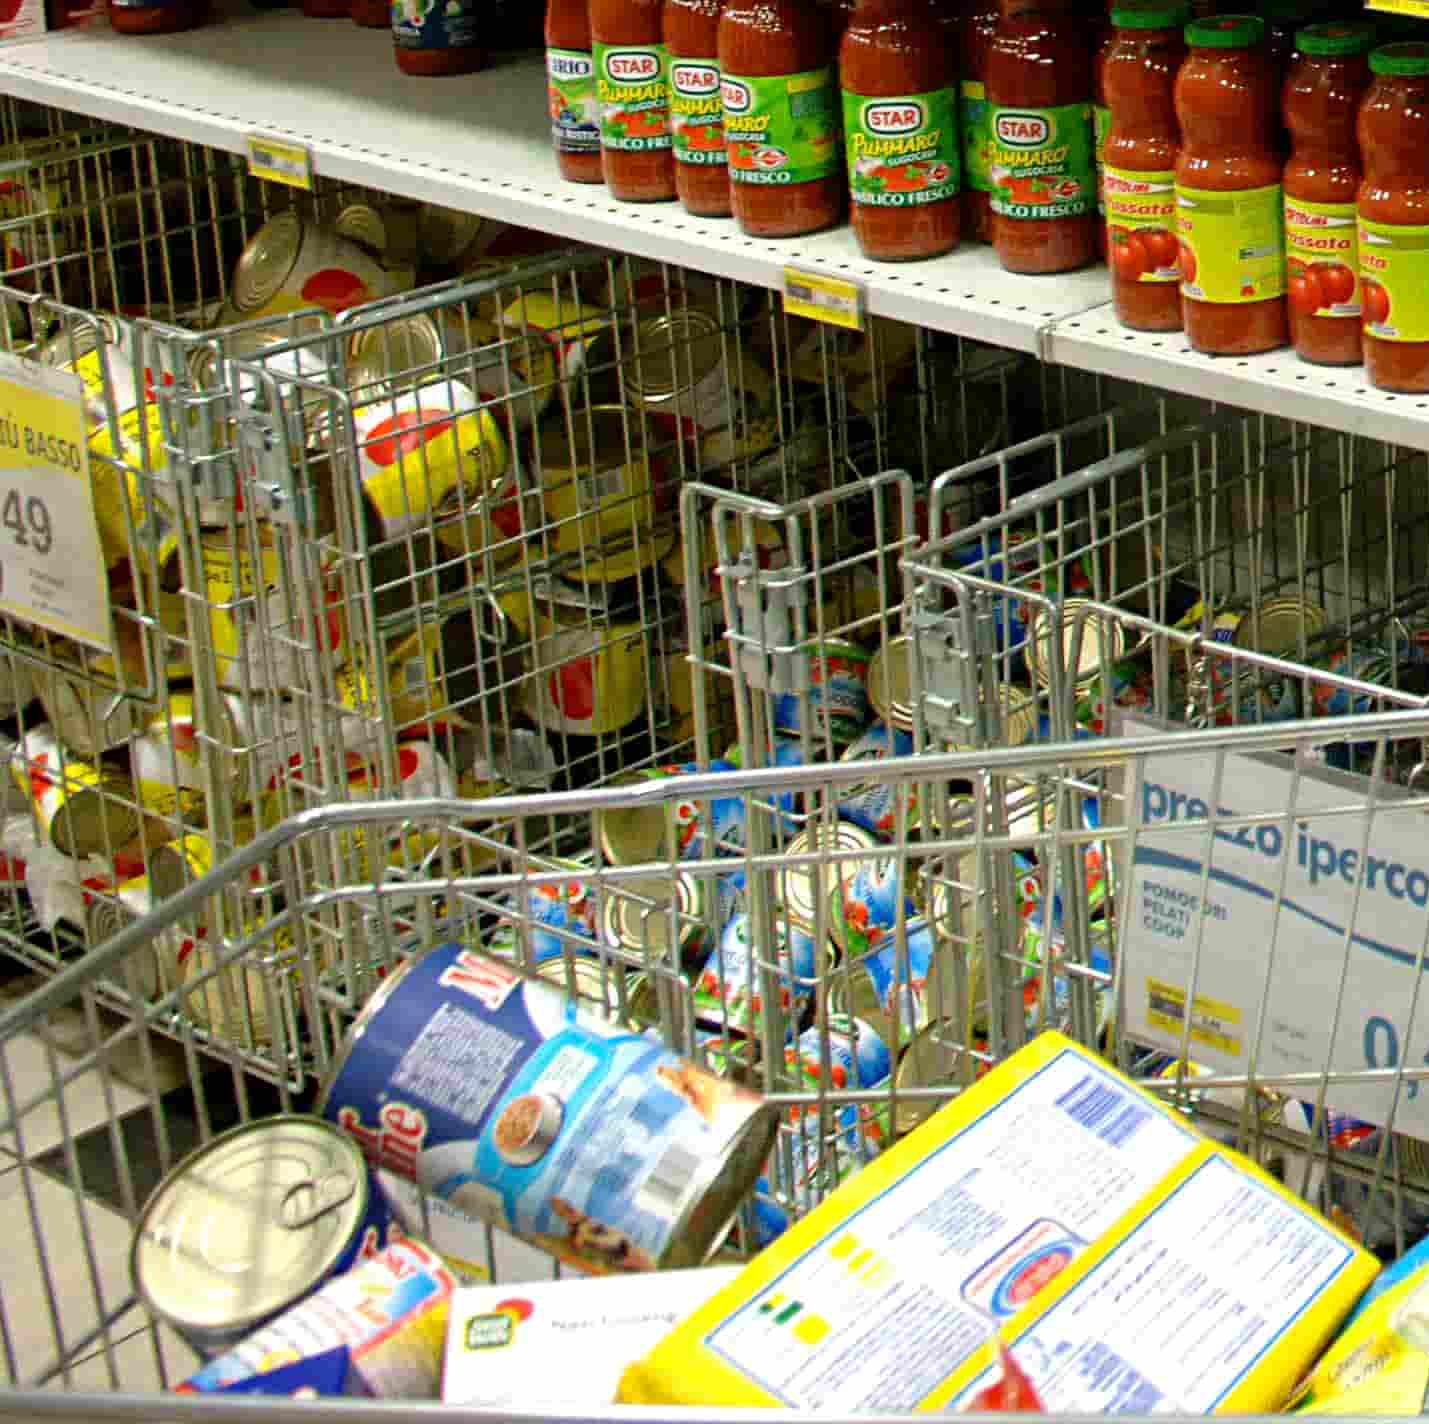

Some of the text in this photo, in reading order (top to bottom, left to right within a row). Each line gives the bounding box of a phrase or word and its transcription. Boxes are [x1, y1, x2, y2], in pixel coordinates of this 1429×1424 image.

[611, 57, 654, 75] STAR
[676, 71, 715, 88] STAR
[870, 110, 917, 127] STAR
[999, 120, 1043, 138] STAR
[738, 169, 791, 185] FRESCO
[907, 183, 956, 204] FRESCO
[1031, 198, 1085, 218] FRESCO
[24, 426, 82, 473] BASSO
[2, 487, 53, 556] 49
[1142, 914, 1187, 941] COOP
